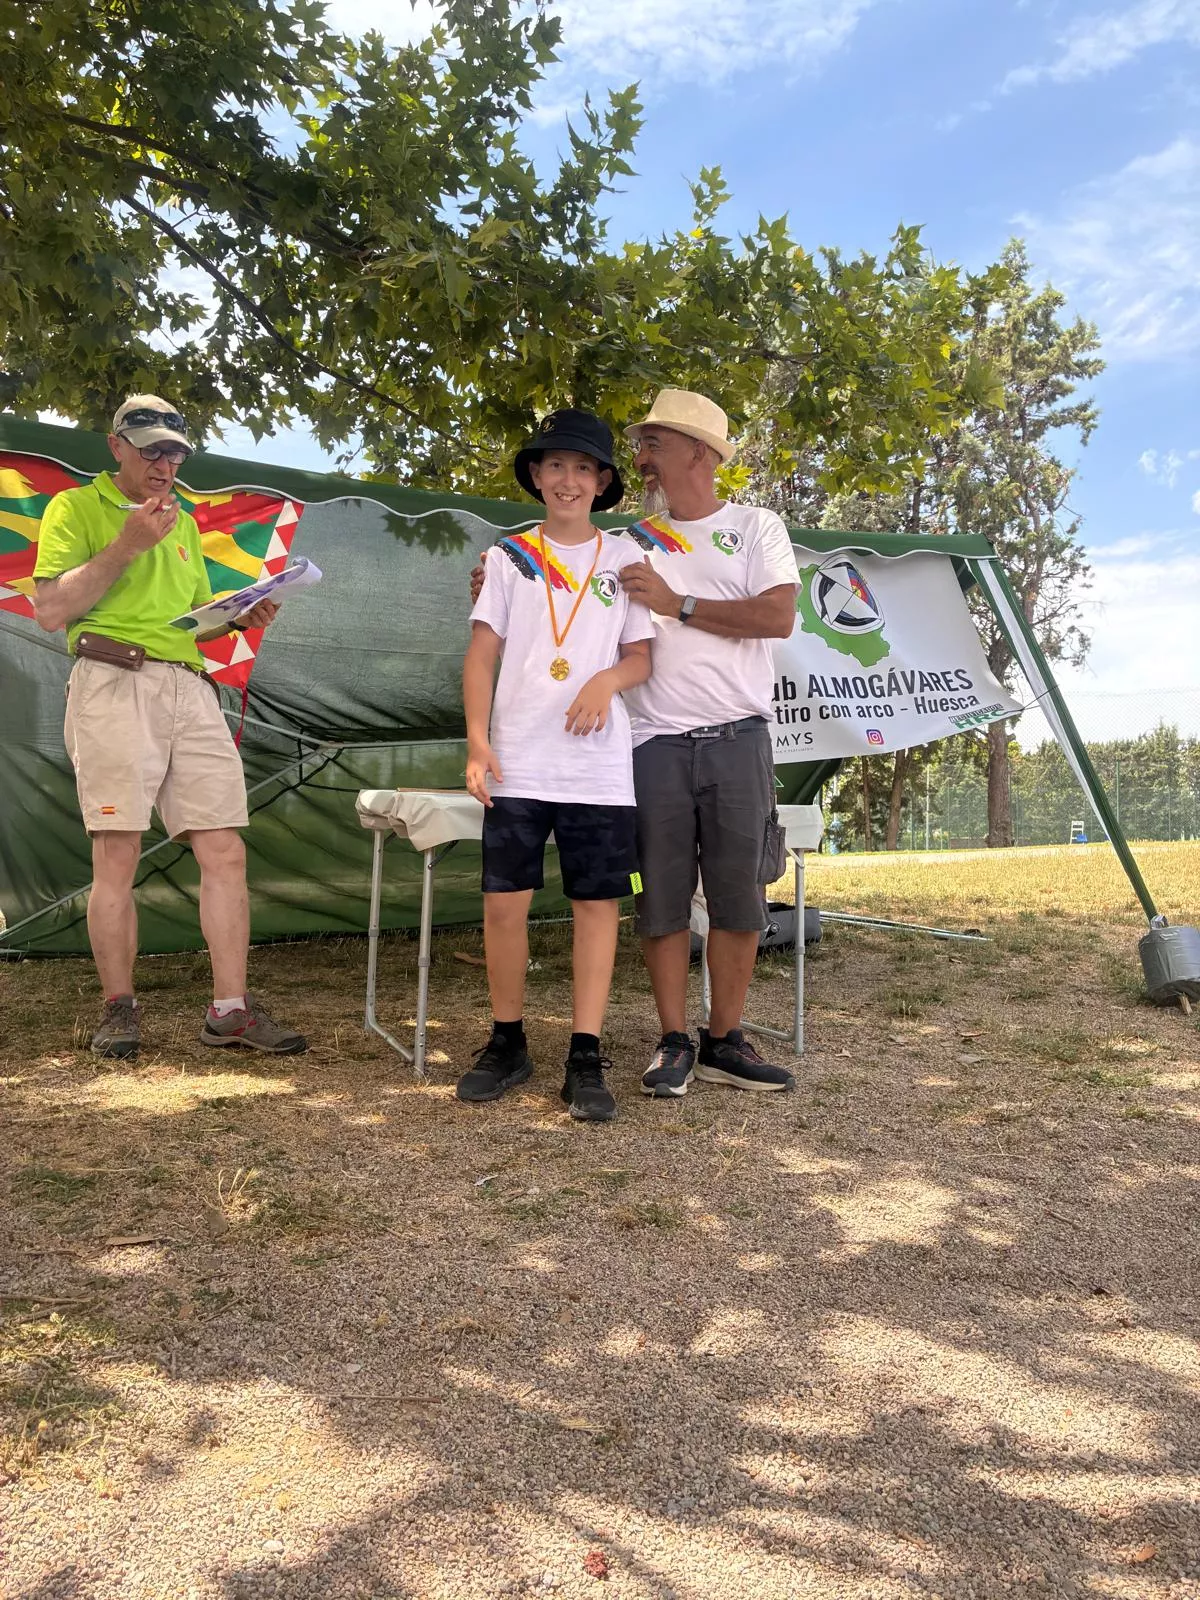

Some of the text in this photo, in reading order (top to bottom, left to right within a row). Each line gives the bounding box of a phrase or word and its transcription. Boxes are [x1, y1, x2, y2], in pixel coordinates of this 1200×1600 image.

[807, 667, 974, 699] ALMOGÁVARES
[775, 704, 811, 724] tiro
[819, 704, 852, 720] con
[856, 704, 895, 718] arco
[914, 695, 980, 714] Huesca
[776, 731, 814, 748] MYS
